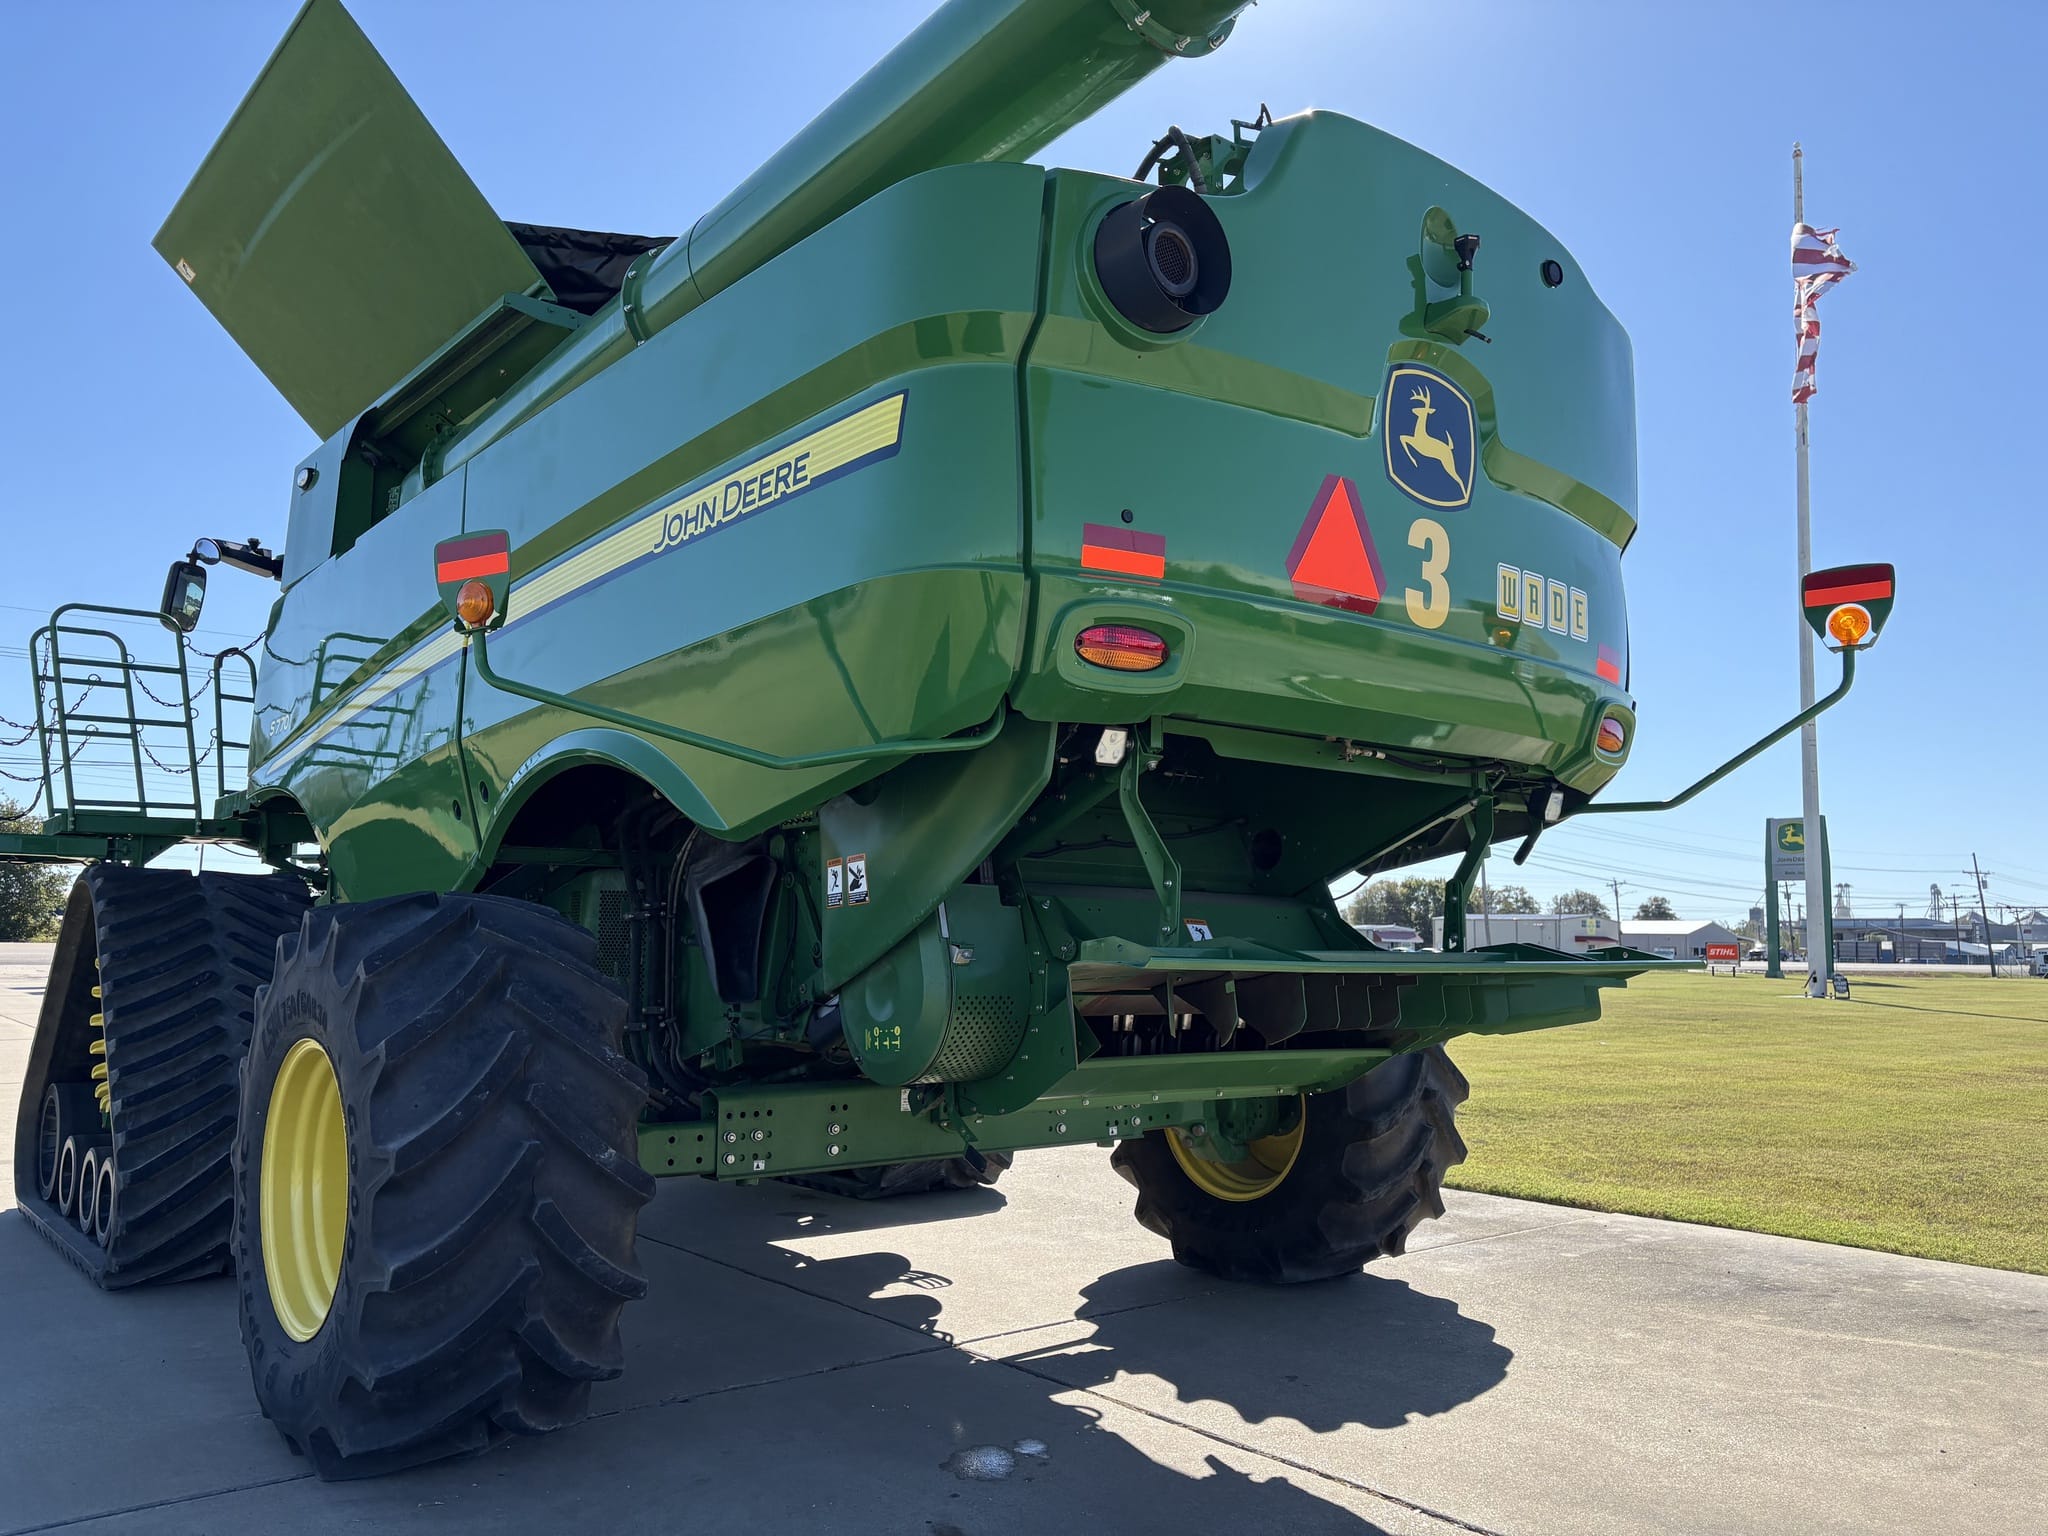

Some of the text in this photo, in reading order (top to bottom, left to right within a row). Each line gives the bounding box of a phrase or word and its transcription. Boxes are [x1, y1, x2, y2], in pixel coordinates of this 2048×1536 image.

[653, 451, 811, 552] JOHN DEERE
[1405, 518, 1450, 629] 3
[1501, 573, 1584, 631] WADE
[269, 714, 290, 736] S770
[1708, 947, 1736, 956] STIHL
